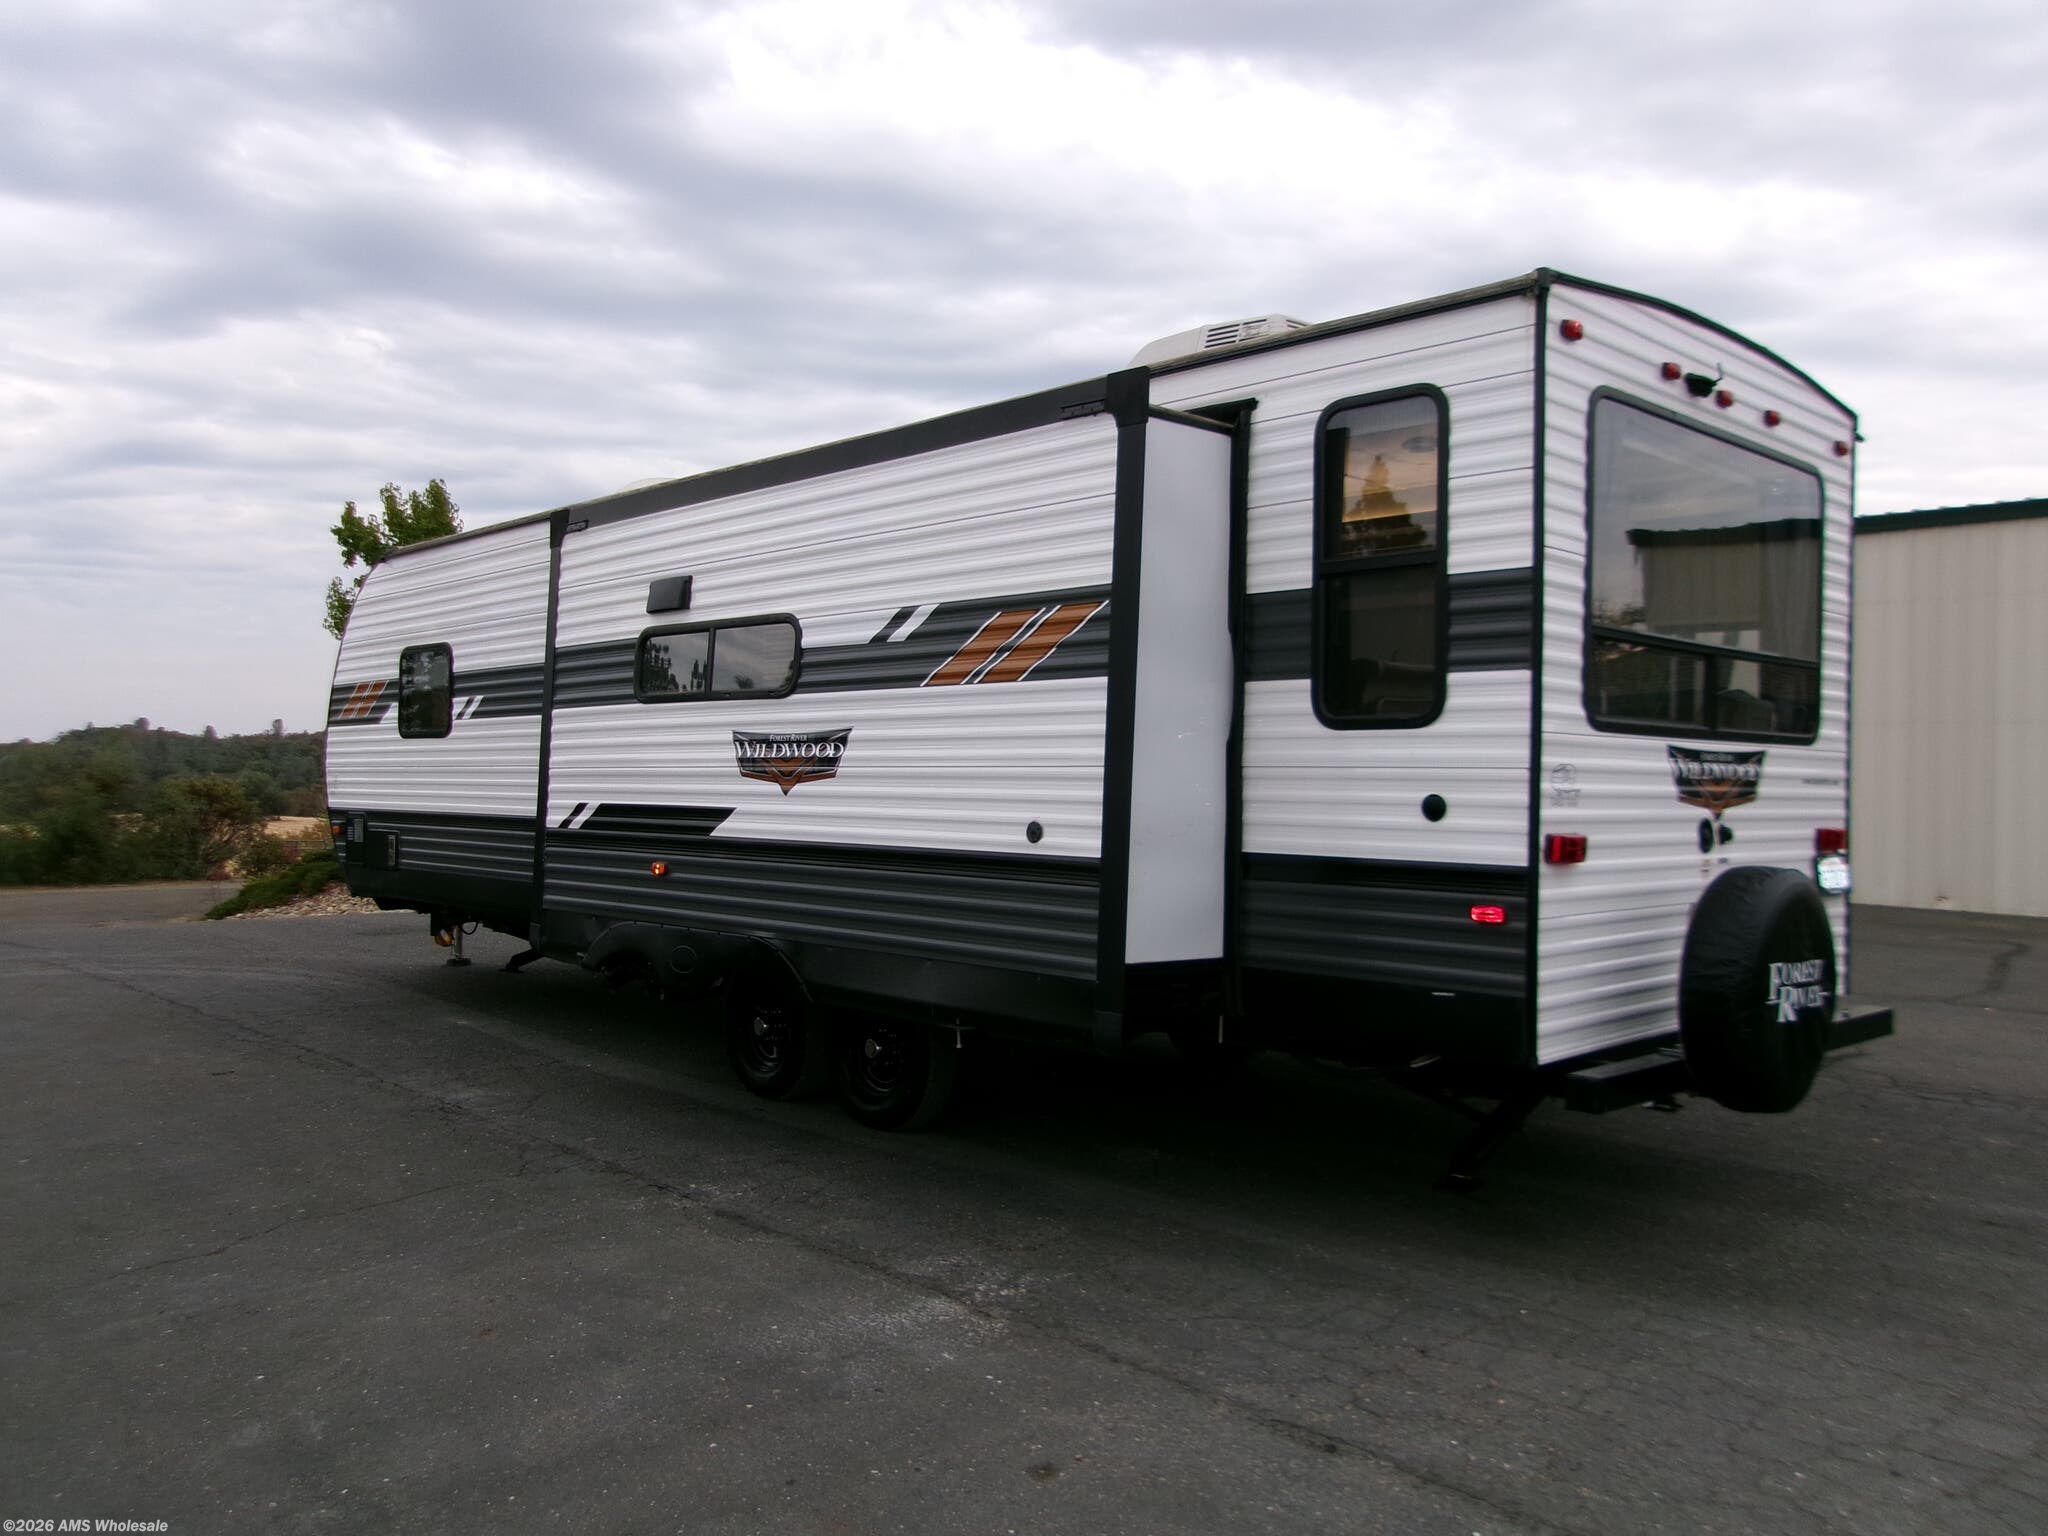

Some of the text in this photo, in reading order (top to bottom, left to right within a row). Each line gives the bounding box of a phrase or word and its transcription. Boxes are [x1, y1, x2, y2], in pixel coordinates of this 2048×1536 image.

[769, 733, 808, 742] FOREST RIVER
[735, 741, 844, 758] WILDWOOD
